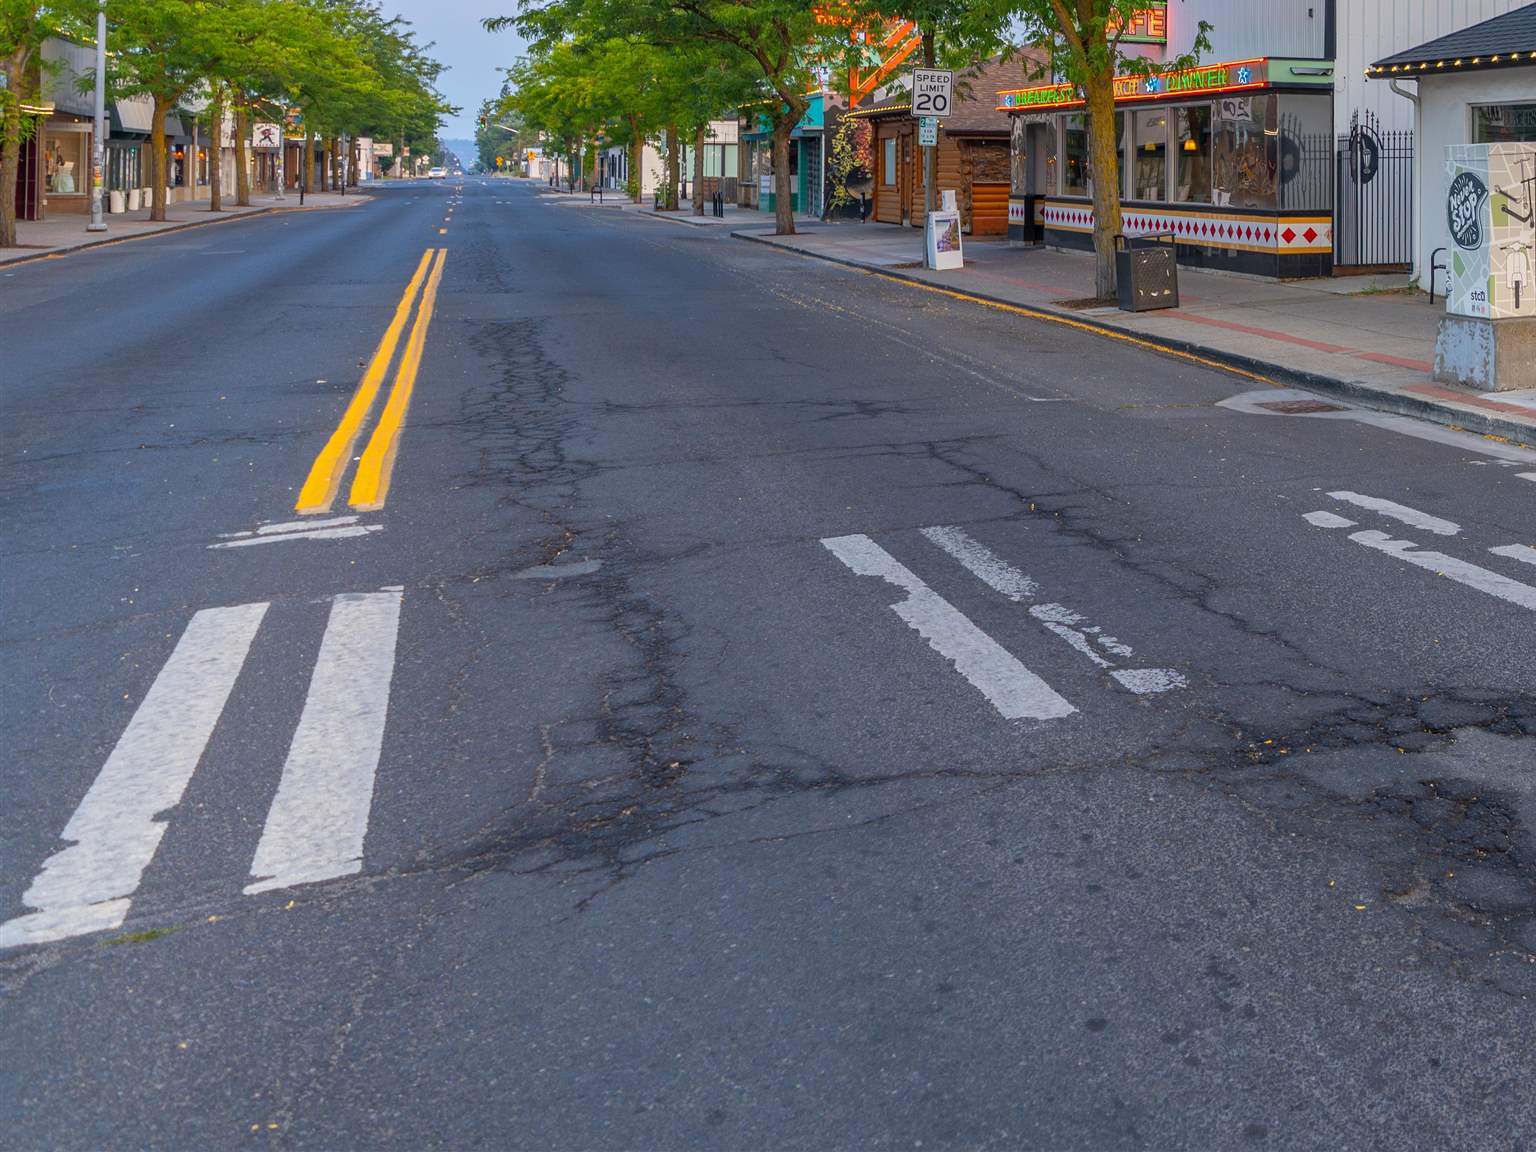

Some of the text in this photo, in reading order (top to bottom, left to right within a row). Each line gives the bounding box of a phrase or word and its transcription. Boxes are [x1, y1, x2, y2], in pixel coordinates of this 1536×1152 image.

[1104, 6, 1164, 36] AFE
[917, 74, 950, 83] SPEED
[1015, 87, 1074, 106] BREAKFAST
[1165, 67, 1228, 91] DINNER
[917, 94, 947, 111] 20
